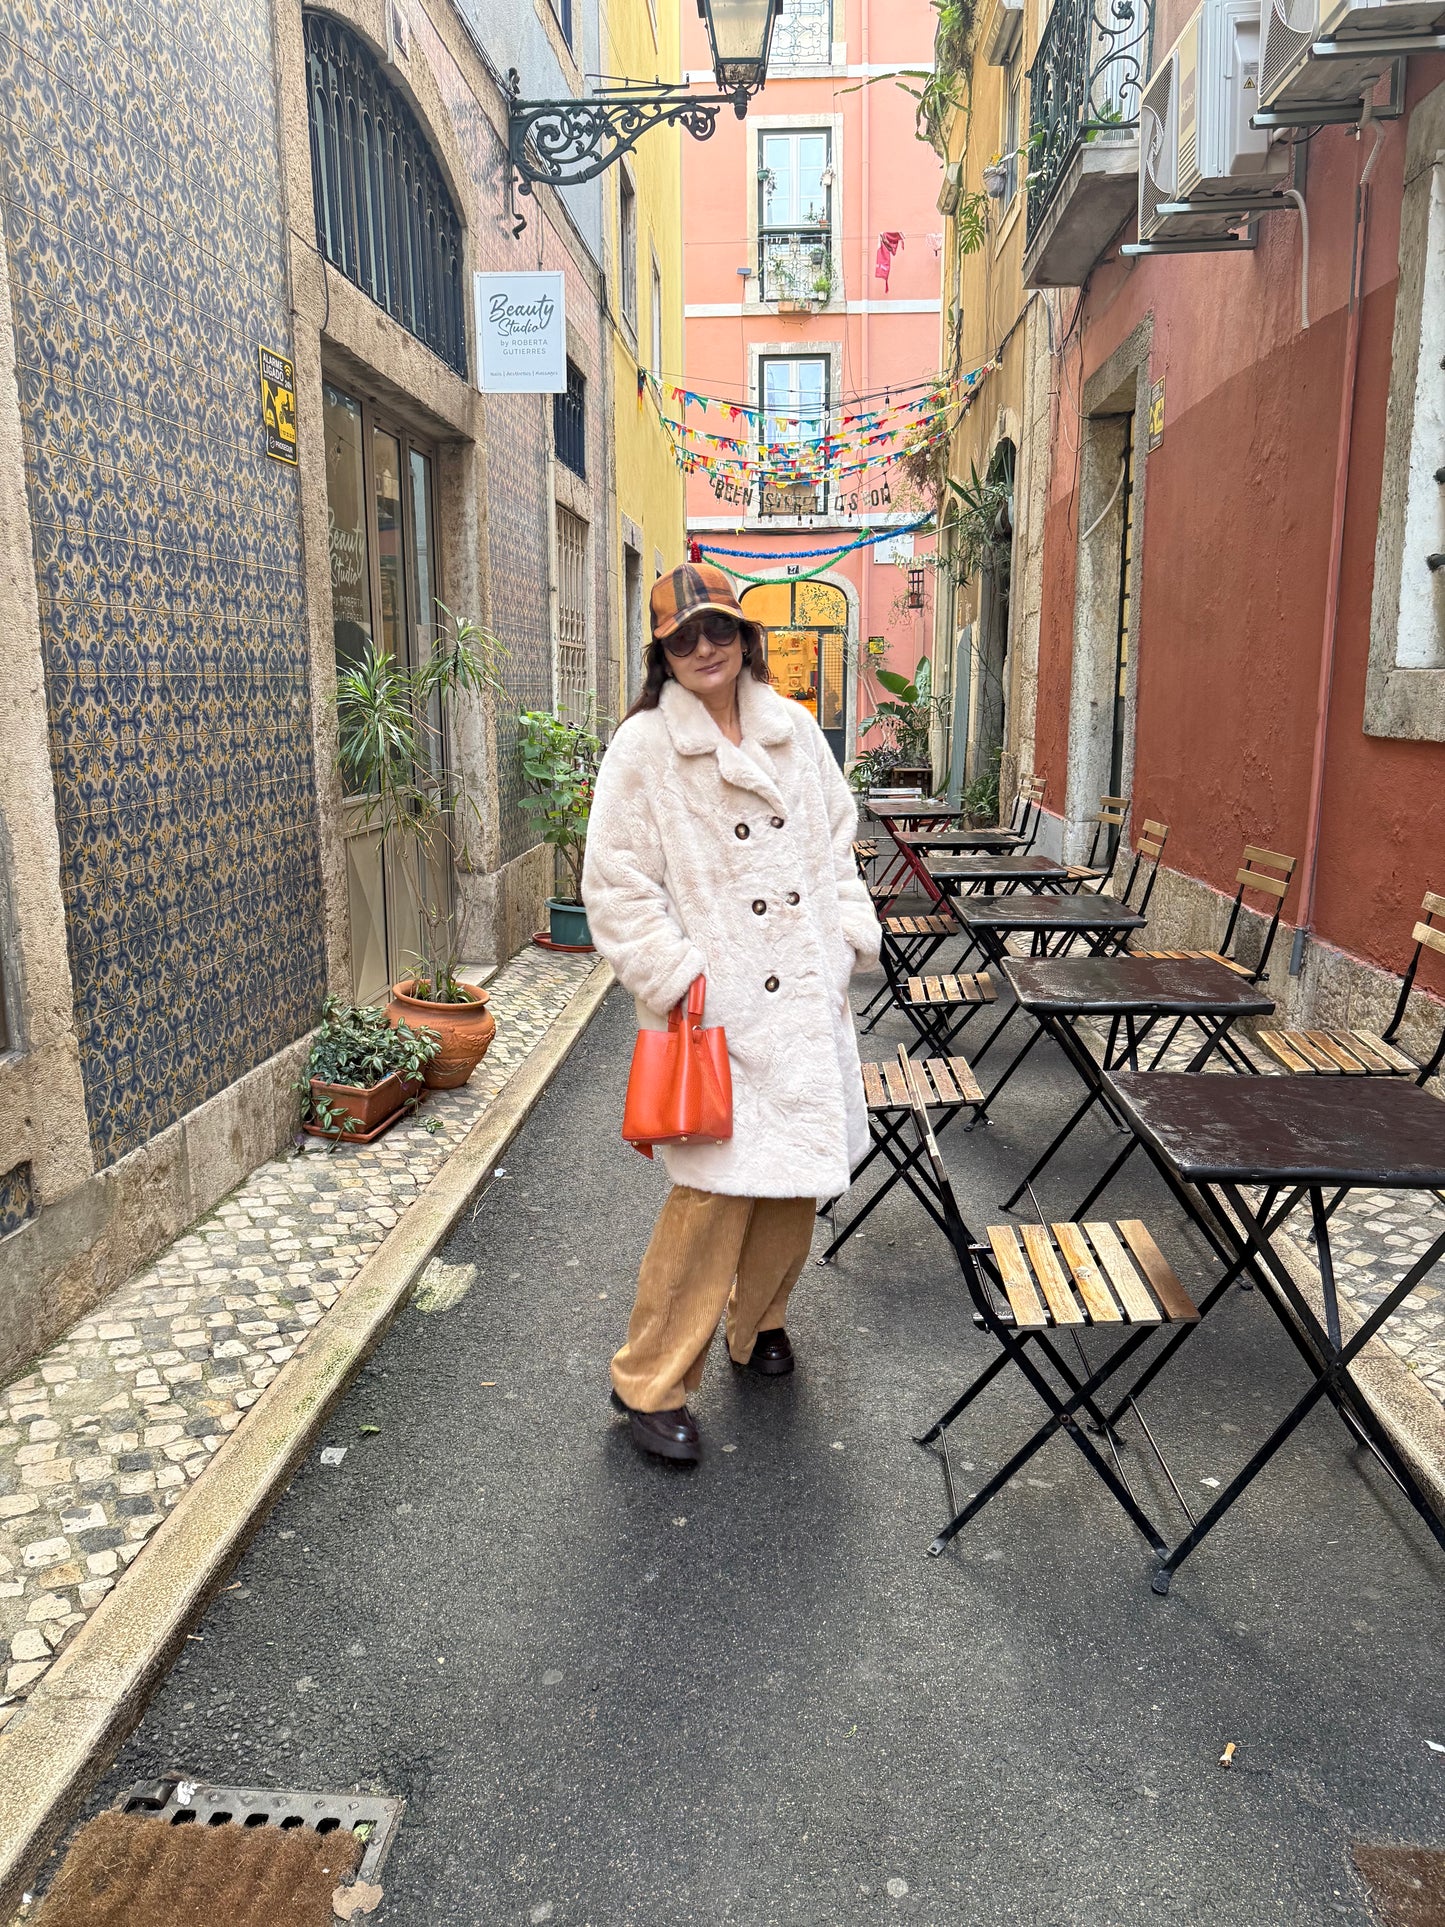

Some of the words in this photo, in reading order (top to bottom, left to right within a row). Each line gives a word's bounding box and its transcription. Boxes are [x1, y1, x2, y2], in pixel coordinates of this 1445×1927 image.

[489, 293, 555, 330] Beauty
[497, 318, 539, 337] Studio
[500, 339, 509, 348] by
[263, 352, 283, 371] ALARME
[263, 362, 285, 382] LIGADO
[330, 552, 359, 588] Studio
